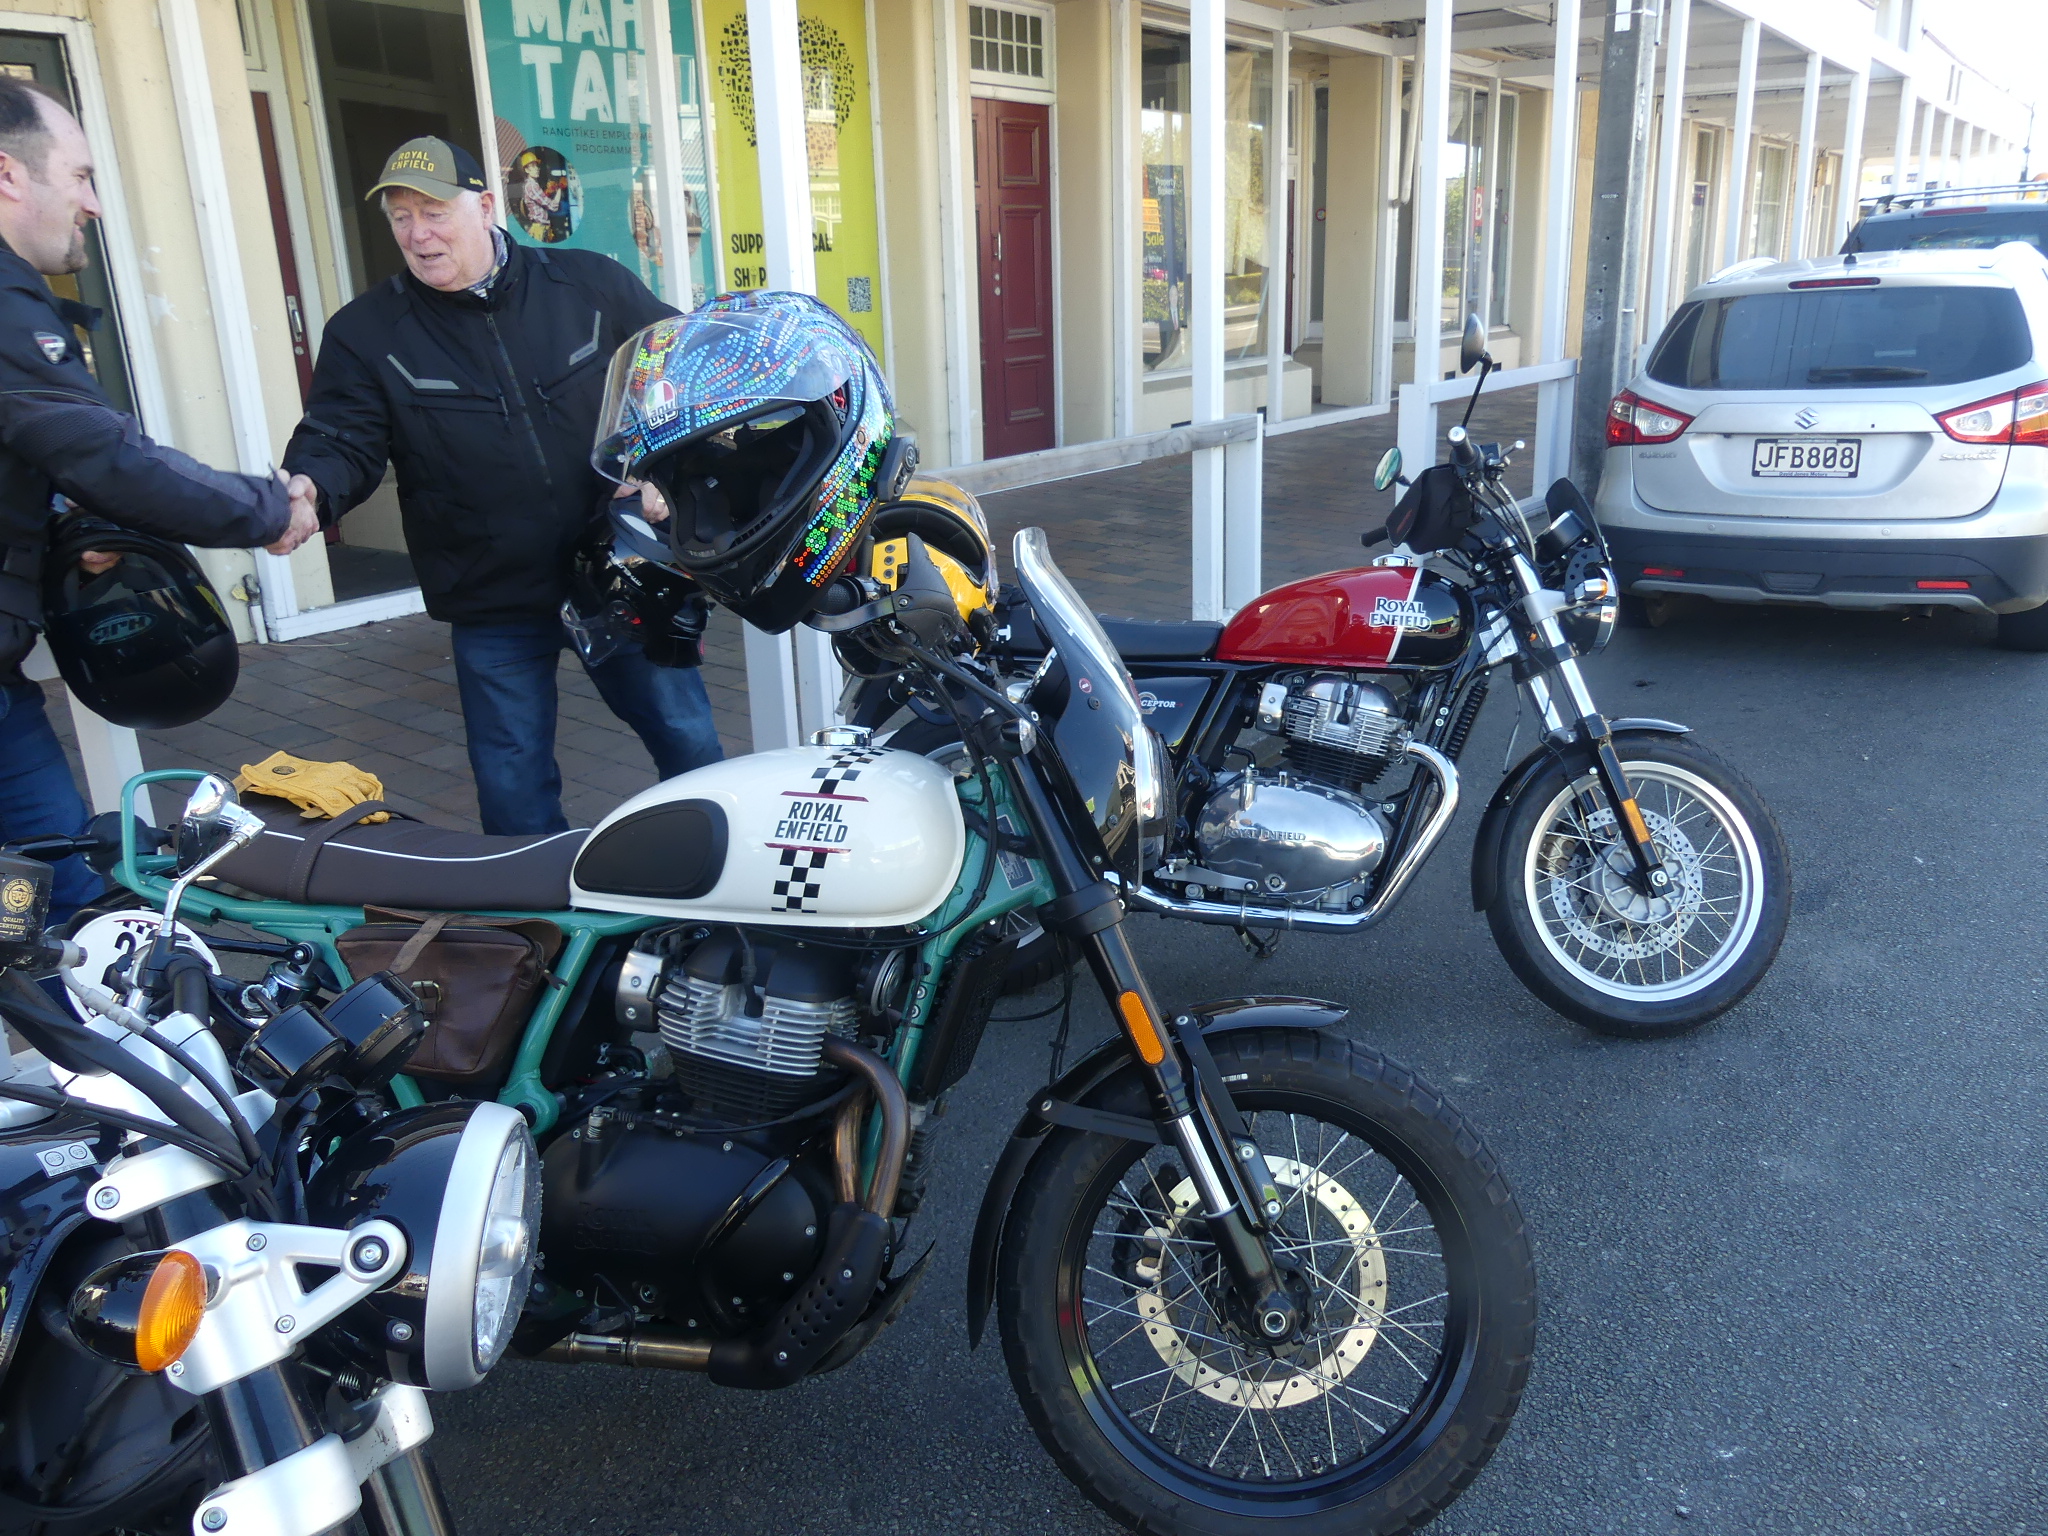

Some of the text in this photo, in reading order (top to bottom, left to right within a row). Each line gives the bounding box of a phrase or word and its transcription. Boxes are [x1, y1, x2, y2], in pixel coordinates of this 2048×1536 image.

[511, 0, 646, 49] MAH
[520, 43, 652, 125] TAH
[602, 130, 653, 142] EMPLOYME
[398, 151, 430, 161] ROYAL
[391, 160, 435, 172] ENFIELD
[731, 232, 832, 254] SUPP CAL
[1145, 232, 1165, 246] Sale
[1759, 446, 1854, 469] JFB808
[1375, 597, 1426, 614] ROYAL
[1369, 612, 1431, 631] ENFIELD
[1141, 699, 1176, 708] CEPTOR
[788, 801, 843, 823] ROYAL
[775, 820, 848, 843] ENFIELD
[1224, 826, 1307, 841] ROYAL ENFIELD
[2, 916, 25, 924] QUALITY
